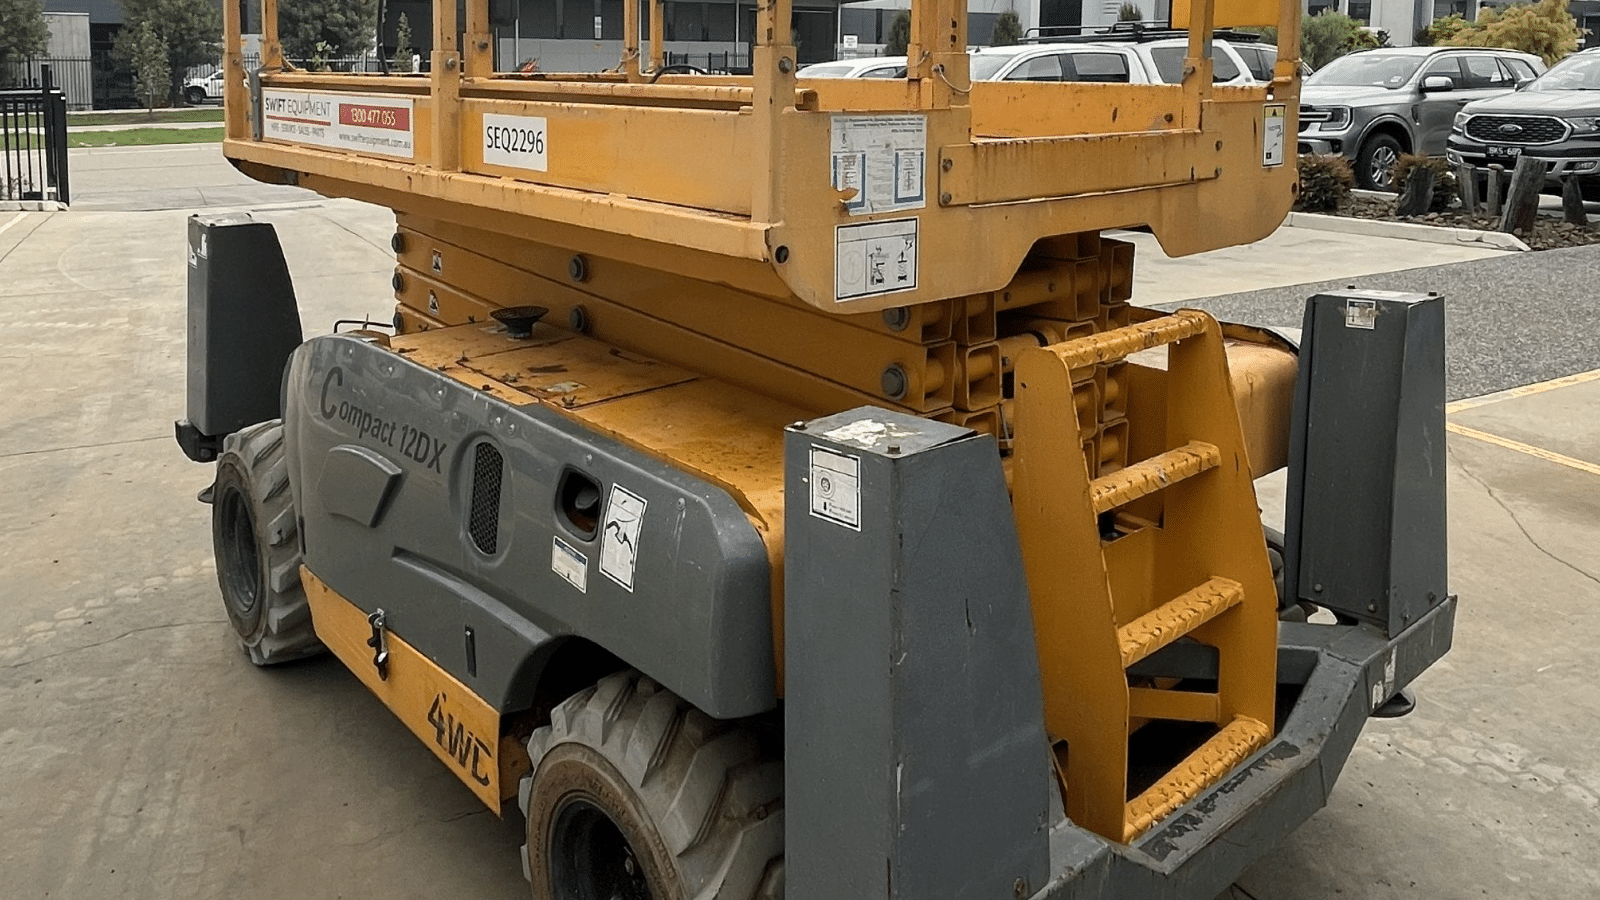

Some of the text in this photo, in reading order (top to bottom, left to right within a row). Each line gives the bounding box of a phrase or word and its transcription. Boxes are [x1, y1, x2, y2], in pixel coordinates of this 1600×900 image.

[265, 97, 331, 117] SWIFT EQUIPMENT
[367, 109, 381, 124] 477
[486, 125, 544, 155] SEQ2296
[320, 365, 448, 475] Compact 12DX
